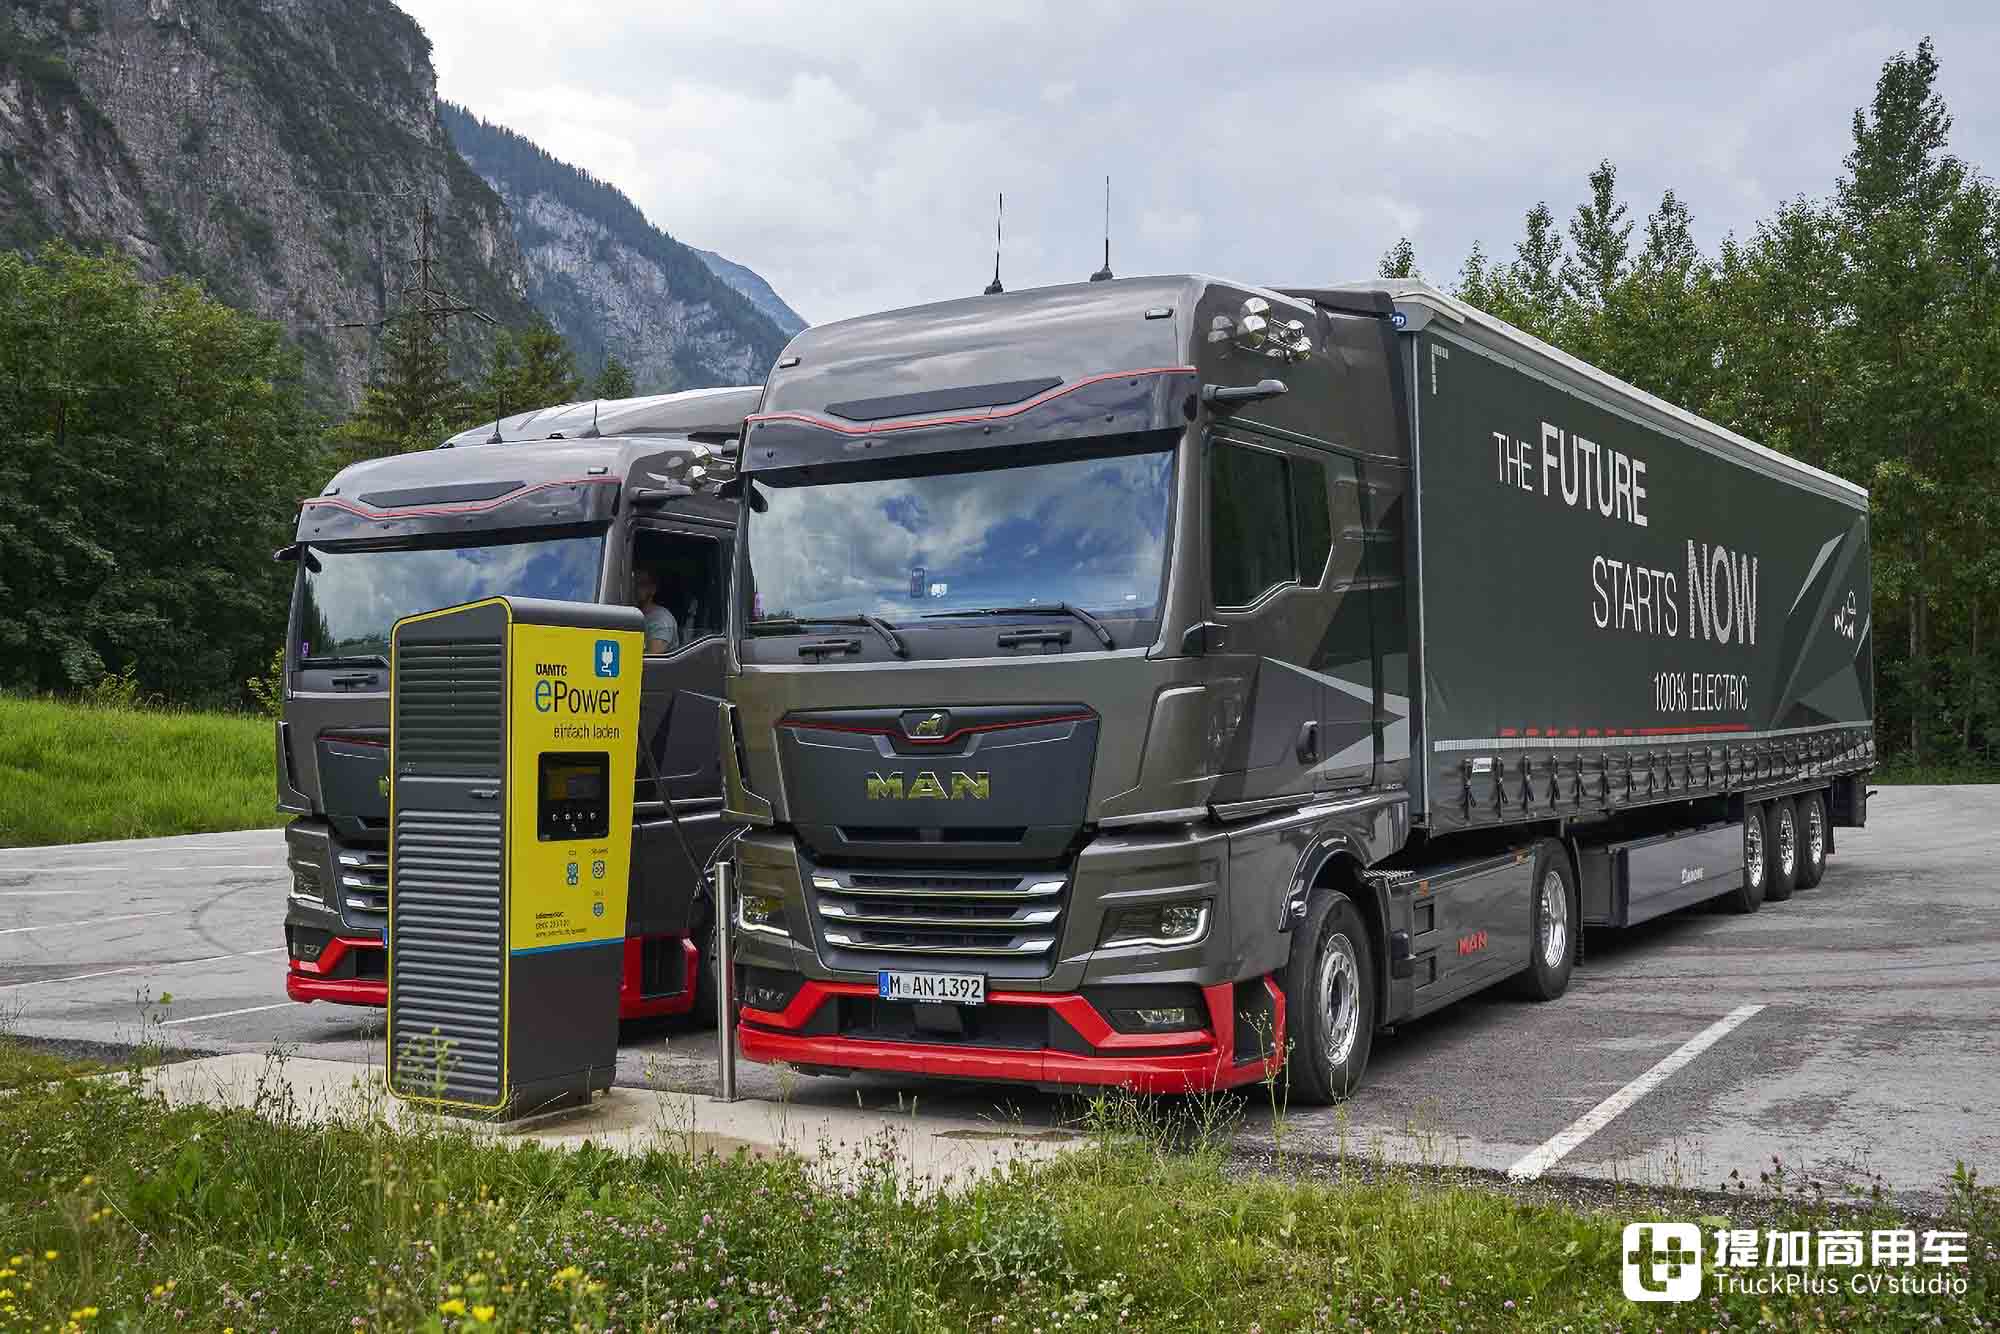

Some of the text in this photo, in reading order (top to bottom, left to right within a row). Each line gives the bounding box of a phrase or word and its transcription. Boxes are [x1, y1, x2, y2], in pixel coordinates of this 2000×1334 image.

[1493, 421, 1648, 527] THE FUTURE
[1592, 539, 1758, 645] STARTS NOW
[535, 679, 619, 714] ePower
[1653, 672, 1749, 712] 100% ELECTRIC
[554, 724, 620, 739] einfach laden
[864, 771, 991, 800] MAN
[1456, 931, 1488, 956] MAN
